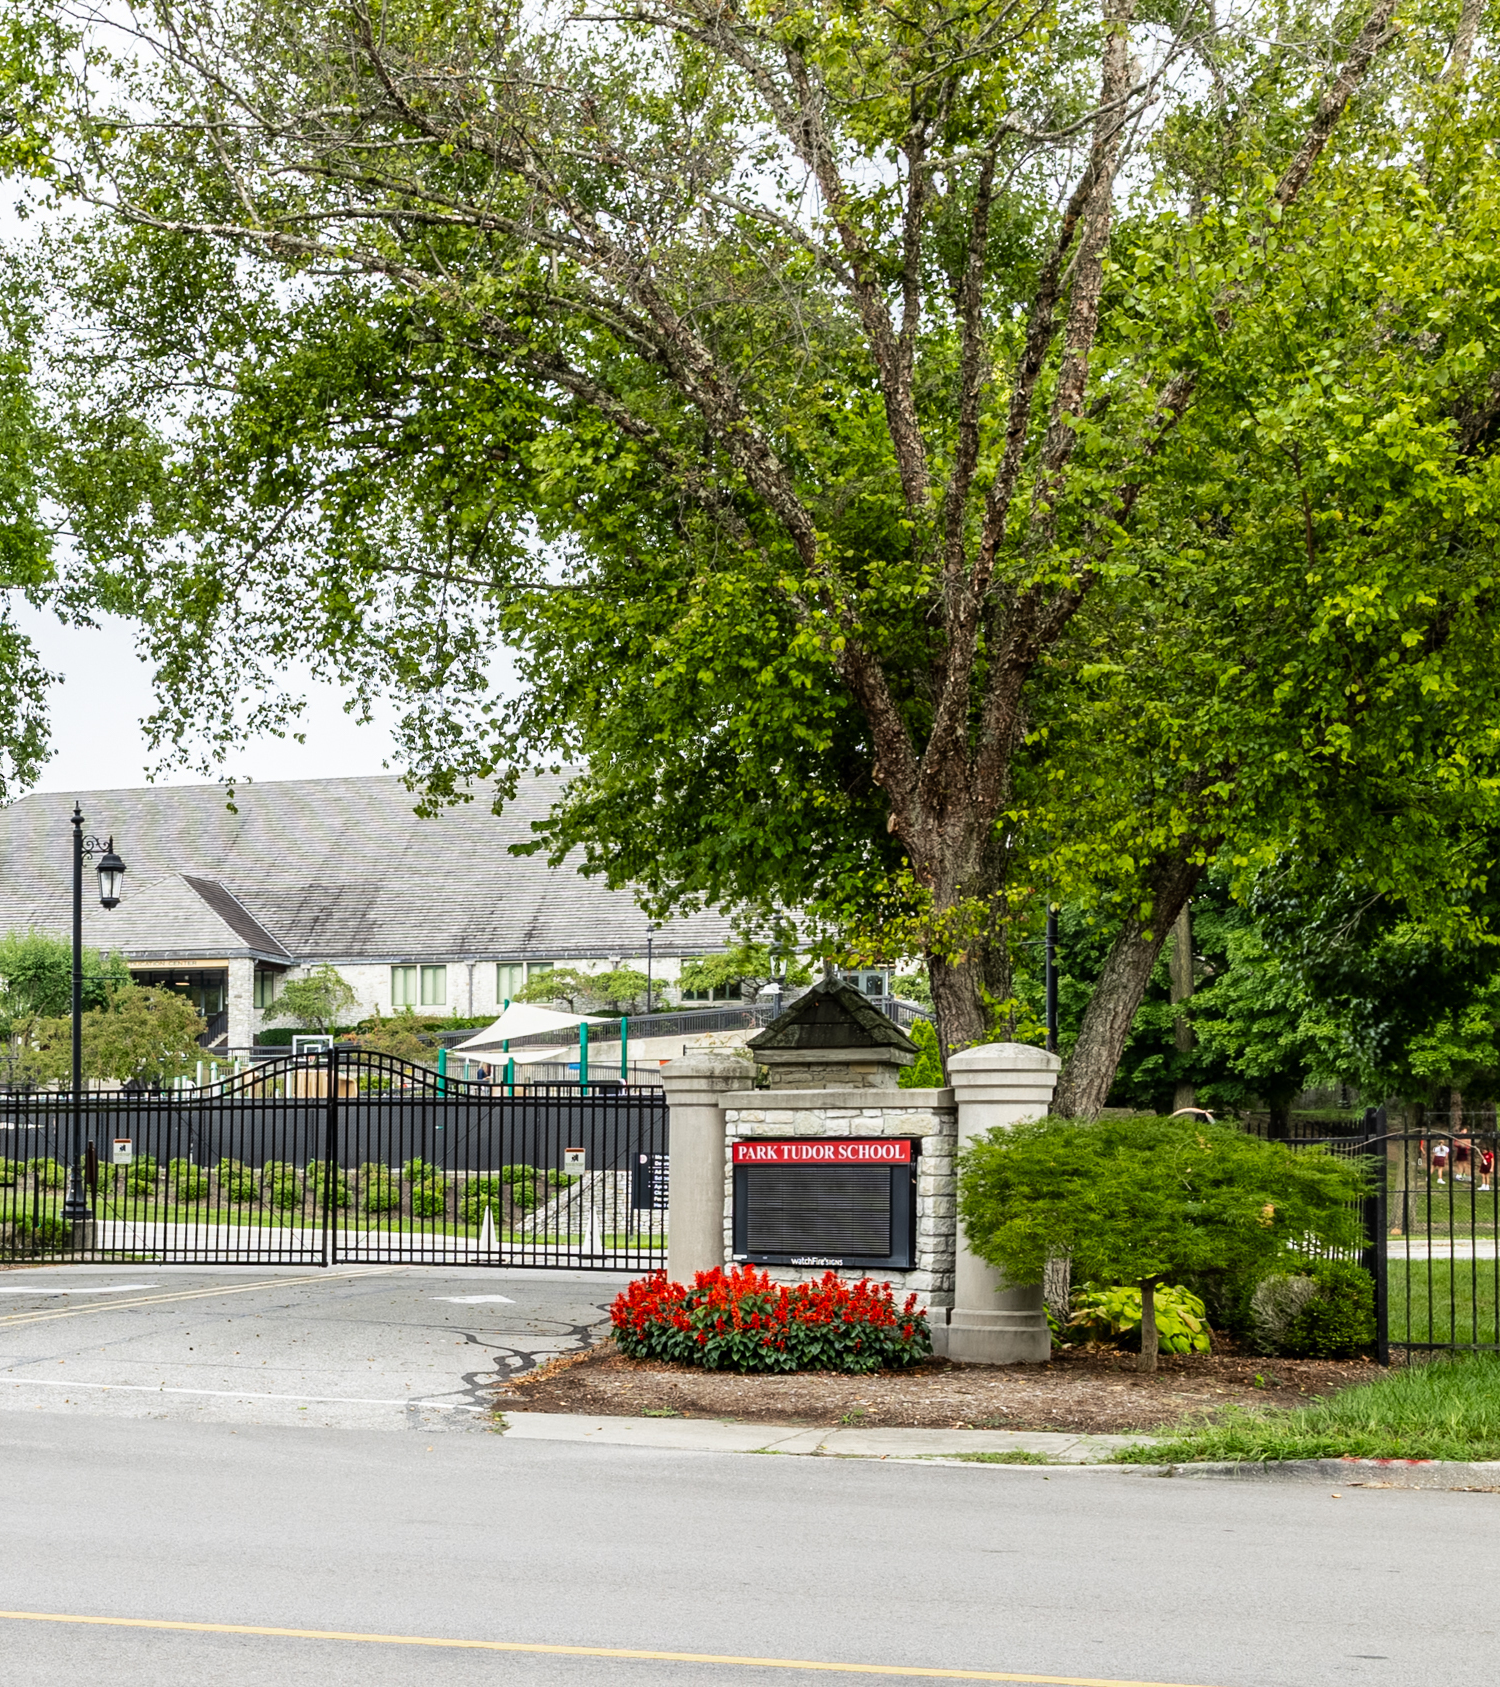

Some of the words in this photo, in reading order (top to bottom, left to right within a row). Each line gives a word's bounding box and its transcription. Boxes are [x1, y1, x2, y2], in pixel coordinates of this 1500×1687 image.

[738, 1145, 778, 1160] PARK
[781, 1144, 835, 1160] TUDOR
[838, 1144, 905, 1159] SCHOOL
